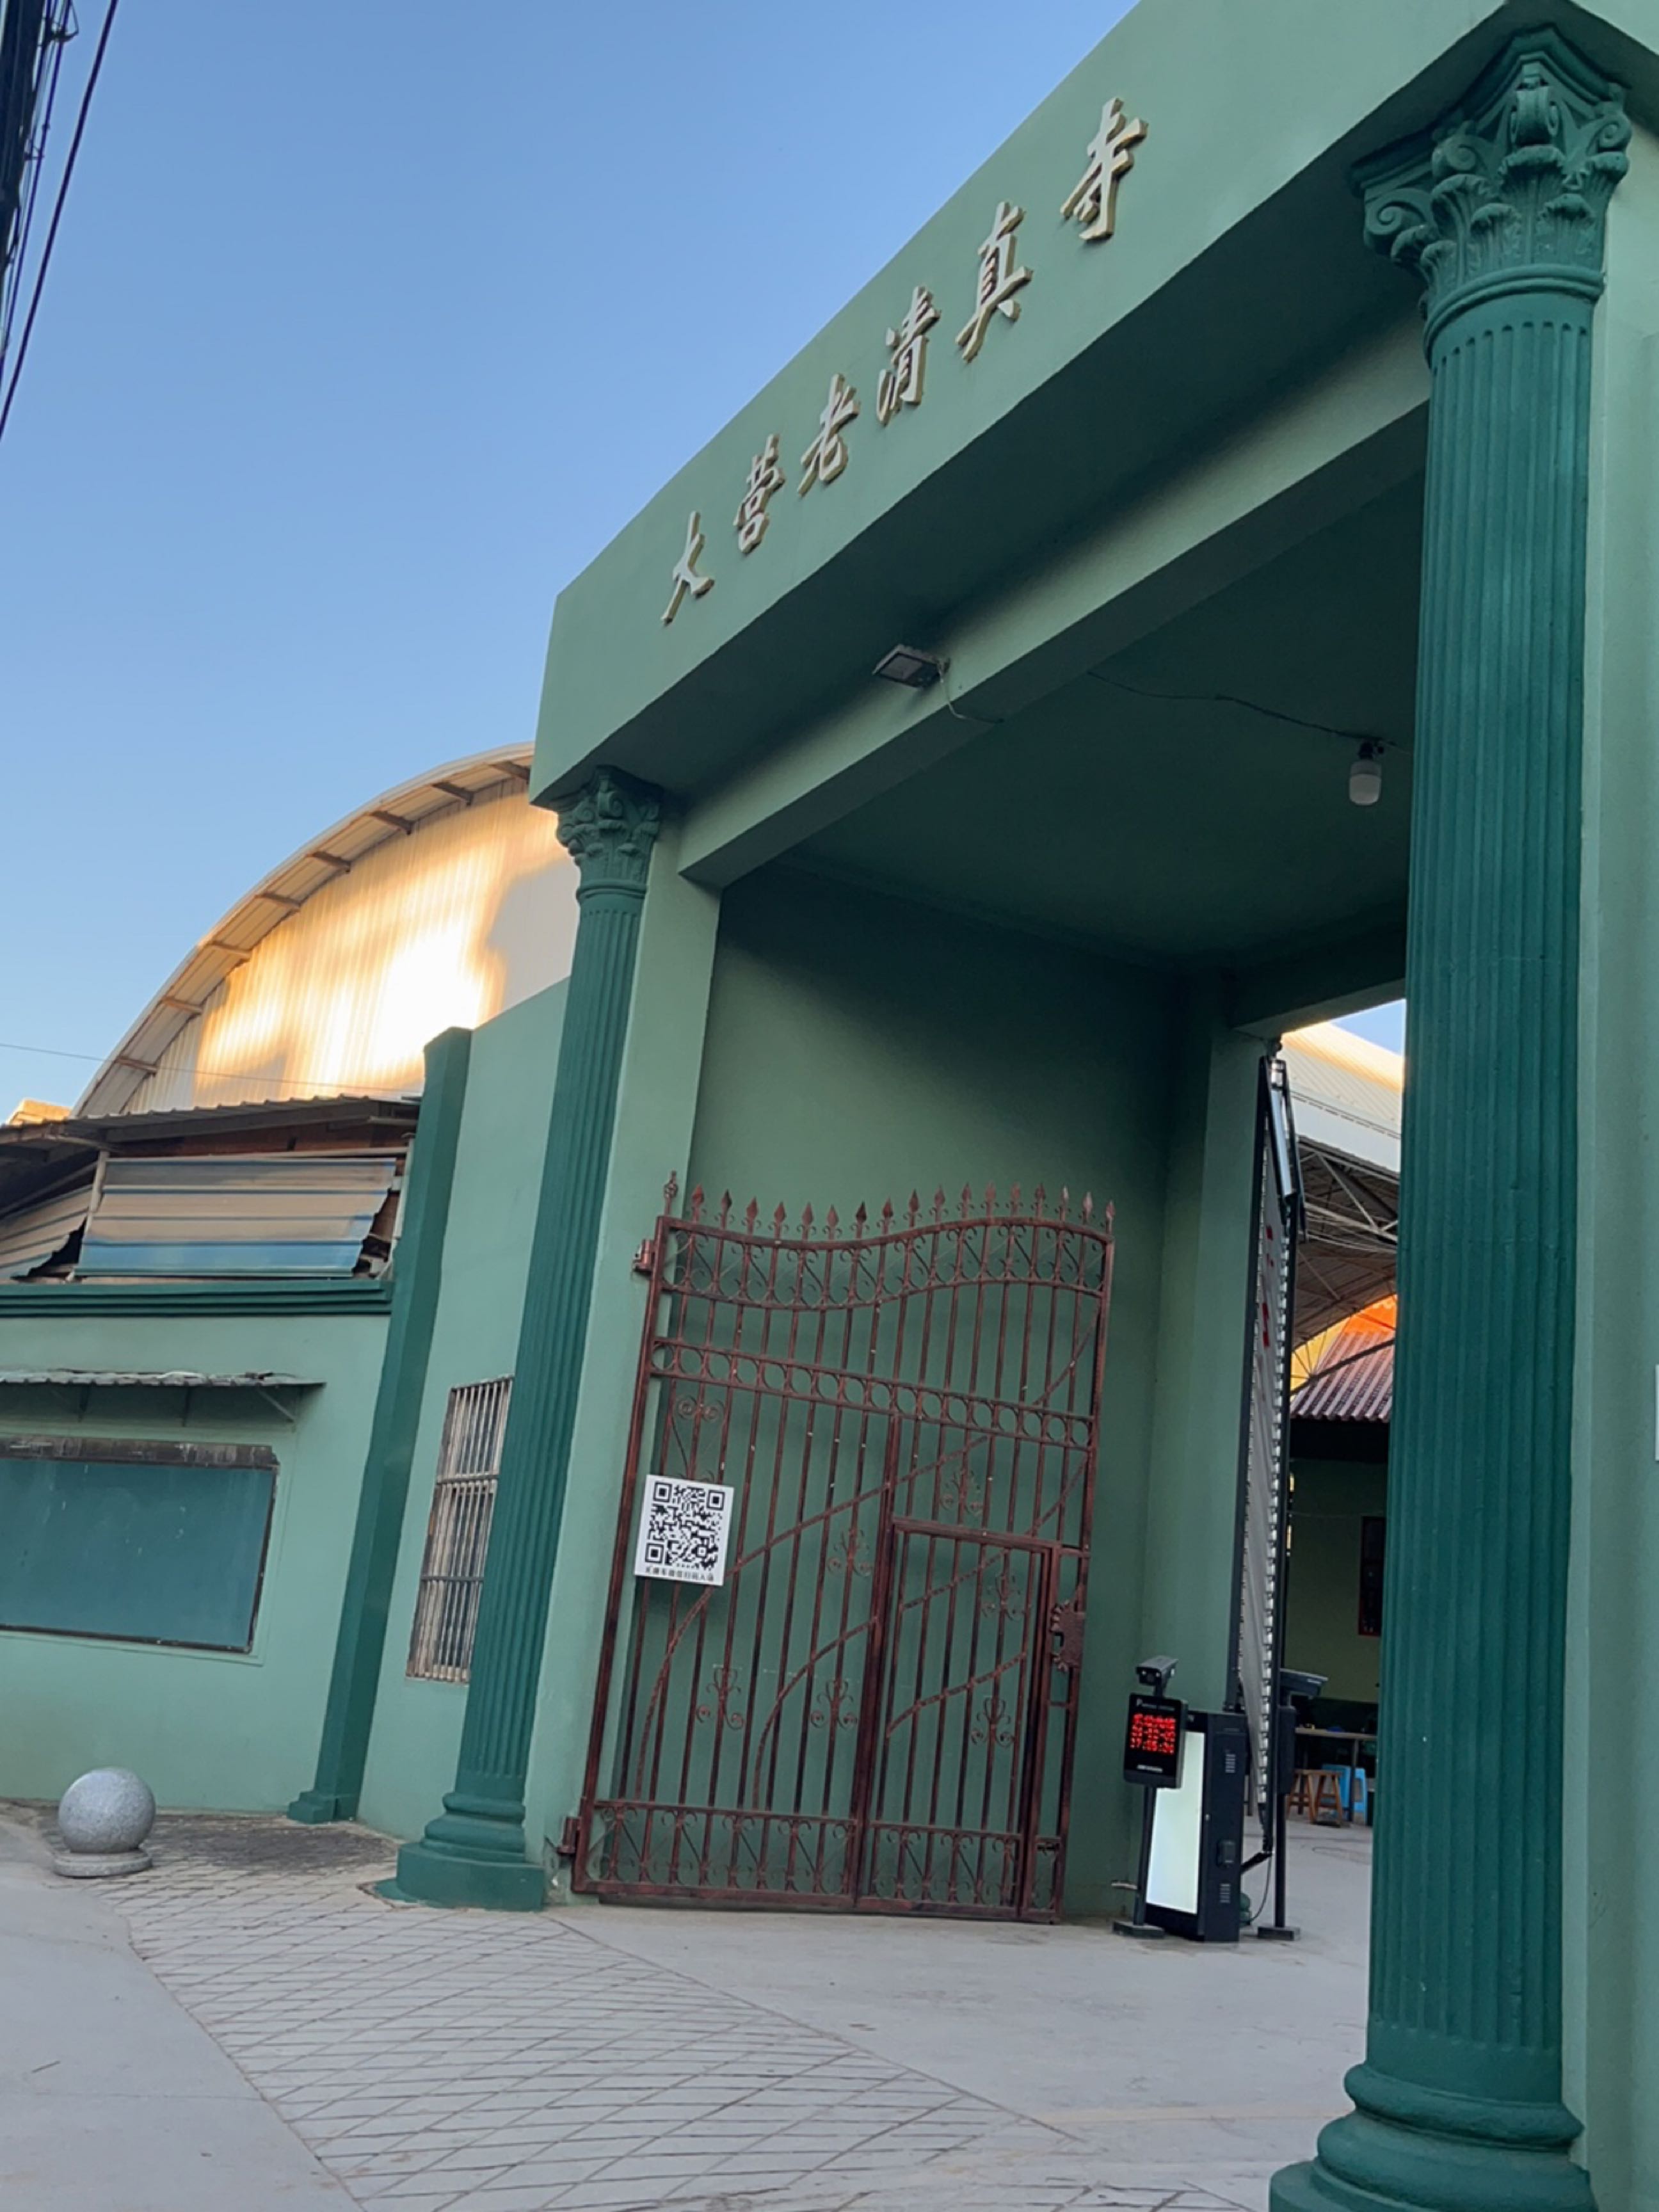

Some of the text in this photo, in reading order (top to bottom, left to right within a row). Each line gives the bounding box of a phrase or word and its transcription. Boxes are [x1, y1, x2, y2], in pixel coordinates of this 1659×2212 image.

[661, 97, 1148, 622] 大营老清真寺
